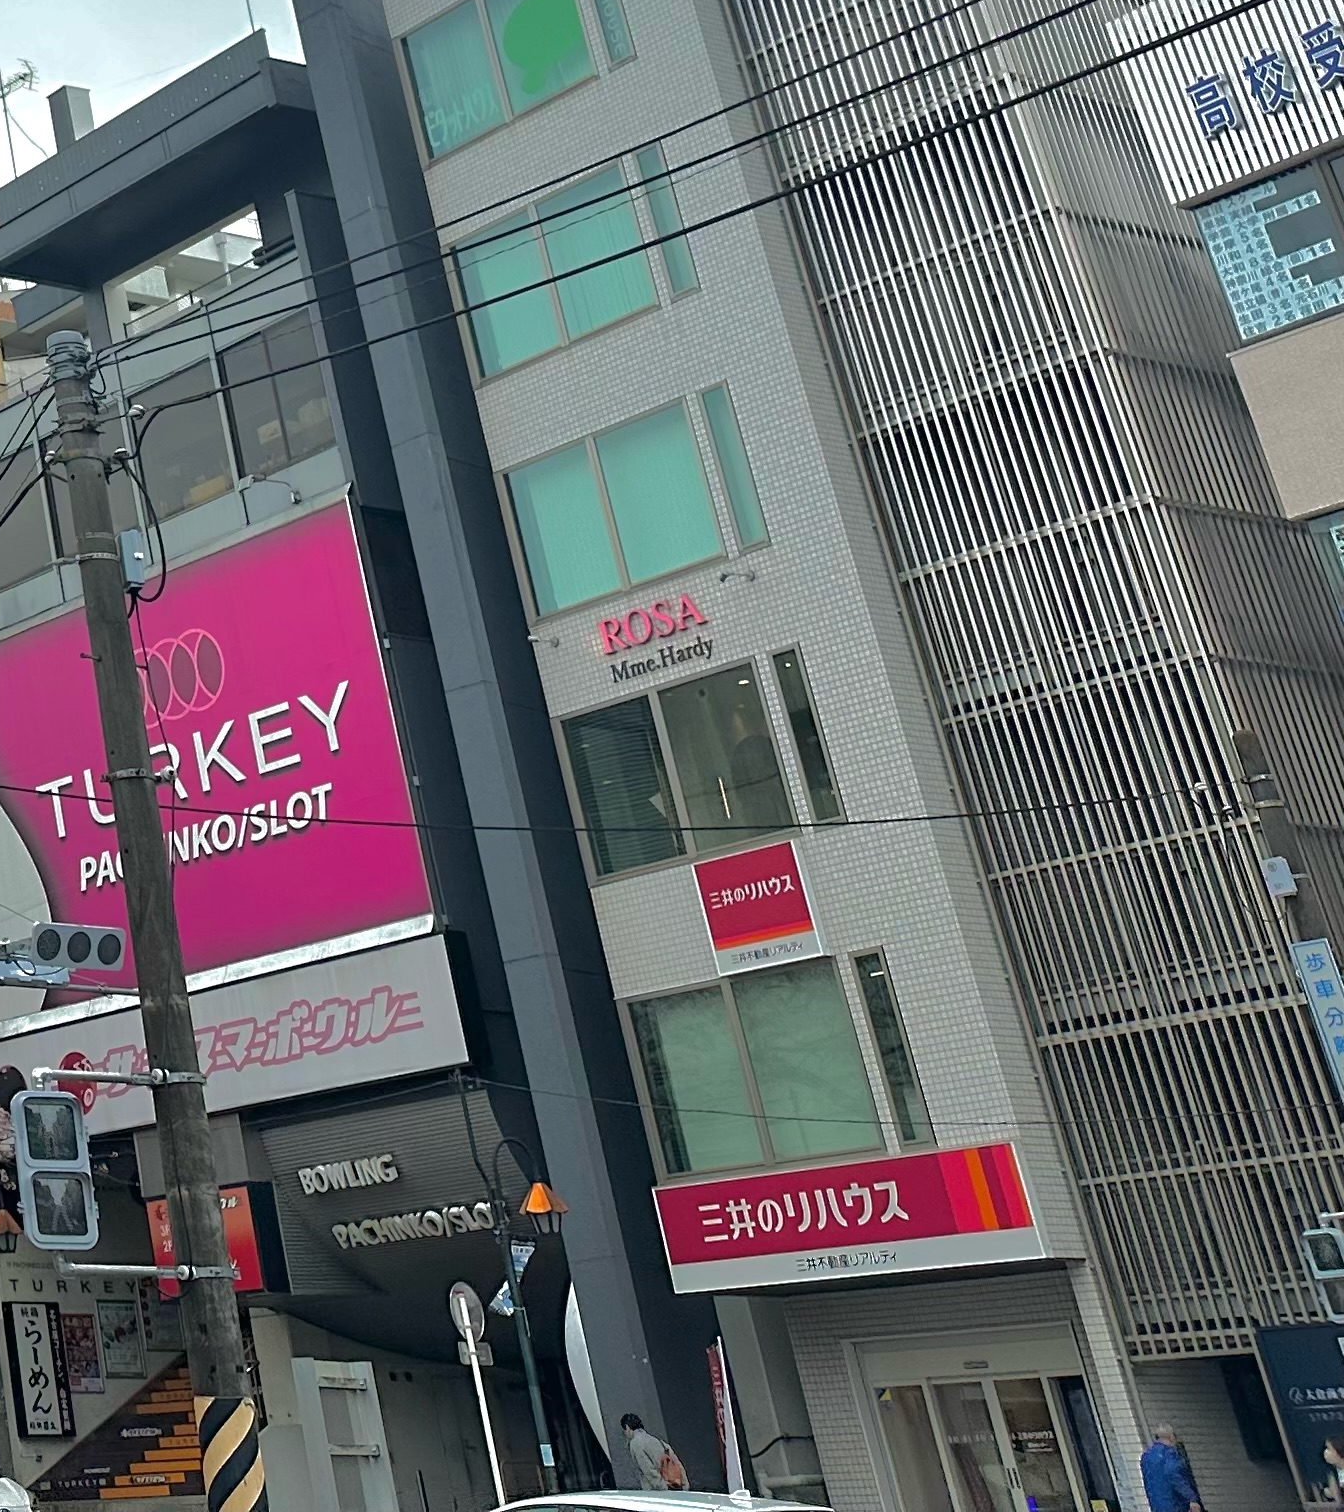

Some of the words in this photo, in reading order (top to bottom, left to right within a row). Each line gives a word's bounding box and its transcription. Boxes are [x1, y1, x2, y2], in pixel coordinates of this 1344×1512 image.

[1185, 19, 1344, 140] 高校受
[596, 591, 708, 656] ROSA
[610, 635, 714, 683] Mme.Hardy
[79, 783, 333, 892] PANKO/SLOT
[708, 874, 796, 910] 三井のリハウス
[297, 1153, 400, 1195] BOWLING
[331, 1201, 495, 1245] PACHINKO/SLO
[697, 1180, 910, 1243] 三井のリハウス
[795, 1250, 898, 1272] 三井不動産リアルティ
[8, 1279, 137, 1294] TURKEY
[24, 1320, 53, 1414] らーめん
